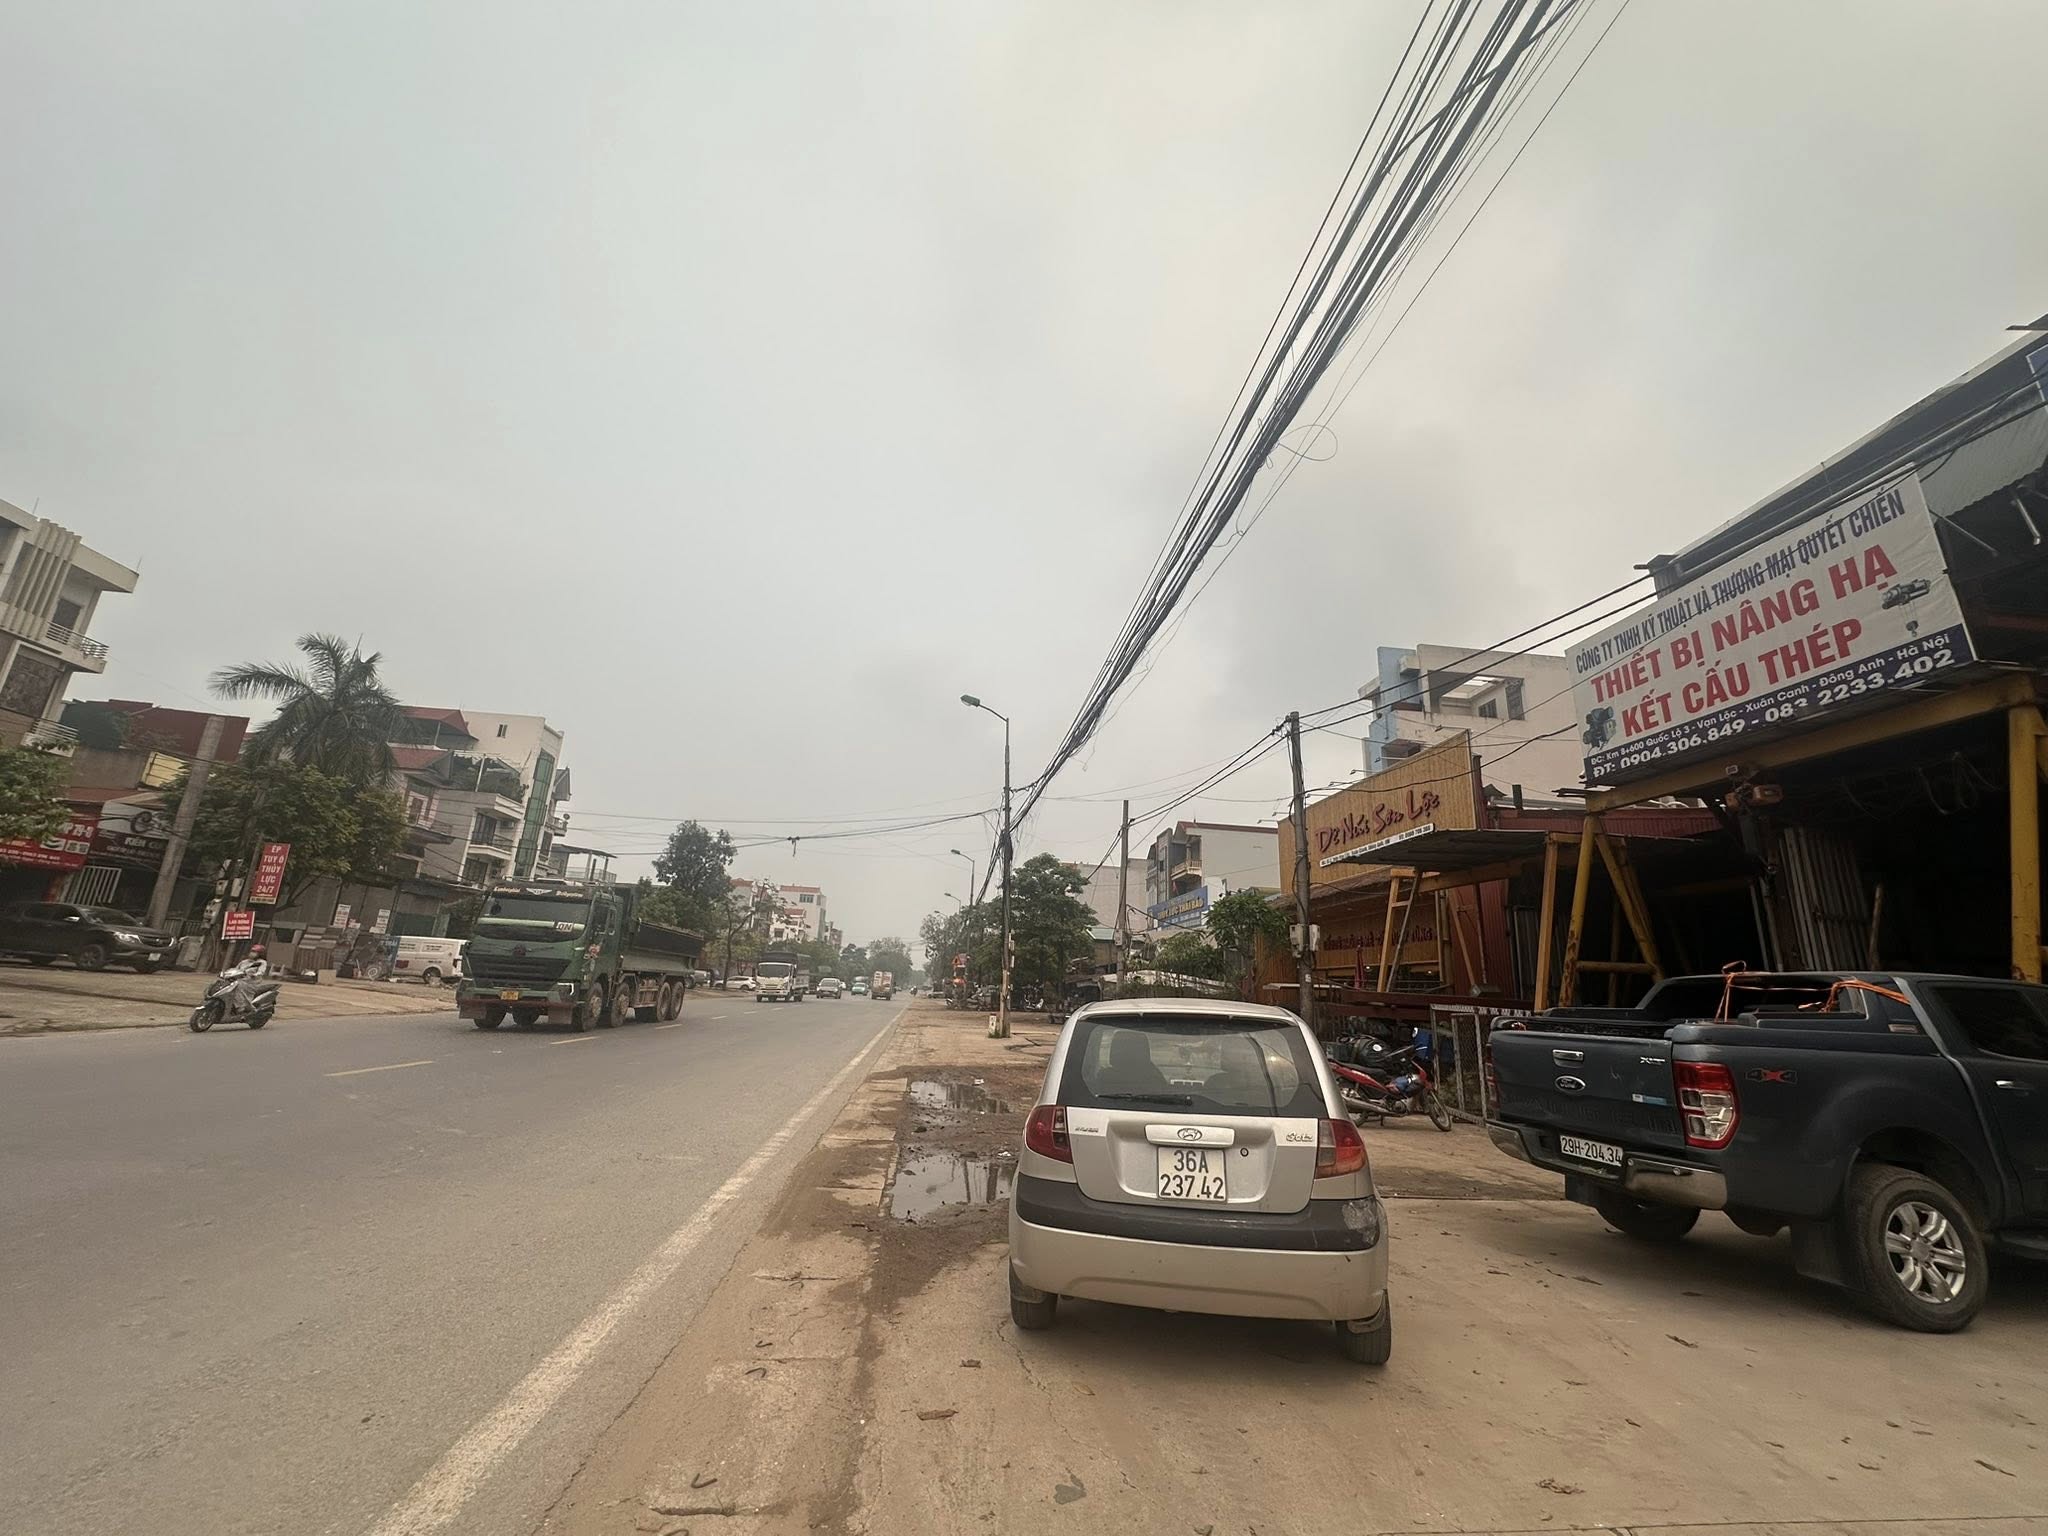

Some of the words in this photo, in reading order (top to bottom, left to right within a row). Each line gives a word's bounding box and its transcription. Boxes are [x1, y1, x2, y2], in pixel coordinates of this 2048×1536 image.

[1576, 645, 1600, 674] CÔNG
[1601, 640, 1613, 661] TY
[1614, 624, 1641, 655] TNHH
[1657, 597, 1693, 628] THUẬT
[1693, 586, 1712, 615] VÀ
[1711, 562, 1765, 606] THƯƠNG
[1765, 545, 1796, 580] MẠI
[1797, 514, 1847, 565] QUYẾT
[1849, 487, 1905, 538] CHIẾN
[1591, 646, 1662, 703] THIẾT
[1670, 628, 1705, 670] BỊ
[1711, 578, 1820, 652] NÂNG
[1828, 544, 1898, 600] HẠ
[1593, 762, 1617, 778] ĐT:
[1620, 718, 1746, 769] 0904.306.849
[1817, 649, 1956, 706] 2233.402
[1621, 689, 1672, 738] KẾT
[1682, 660, 1750, 714] CẤU
[1758, 618, 1863, 685] THÉP
[1646, 731, 1671, 747] Quốc
[1671, 727, 1682, 739] Lộ
[1684, 726, 1691, 735] 3
[1697, 717, 1718, 730] Vạn
[1718, 708, 1737, 722] Lộc
[1777, 683, 1810, 702] Canh
[1818, 667, 1855, 688] Đông
[1858, 656, 1886, 674] Anh
[1897, 643, 1919, 660] Hà
[1922, 633, 1951, 651] Nội
[256, 885, 275, 894] 24/7
[1160, 1173, 1225, 1200] 237.42
[1173, 1149, 1209, 1174] 36A
[1561, 1136, 1622, 1163] 29H-204.34
